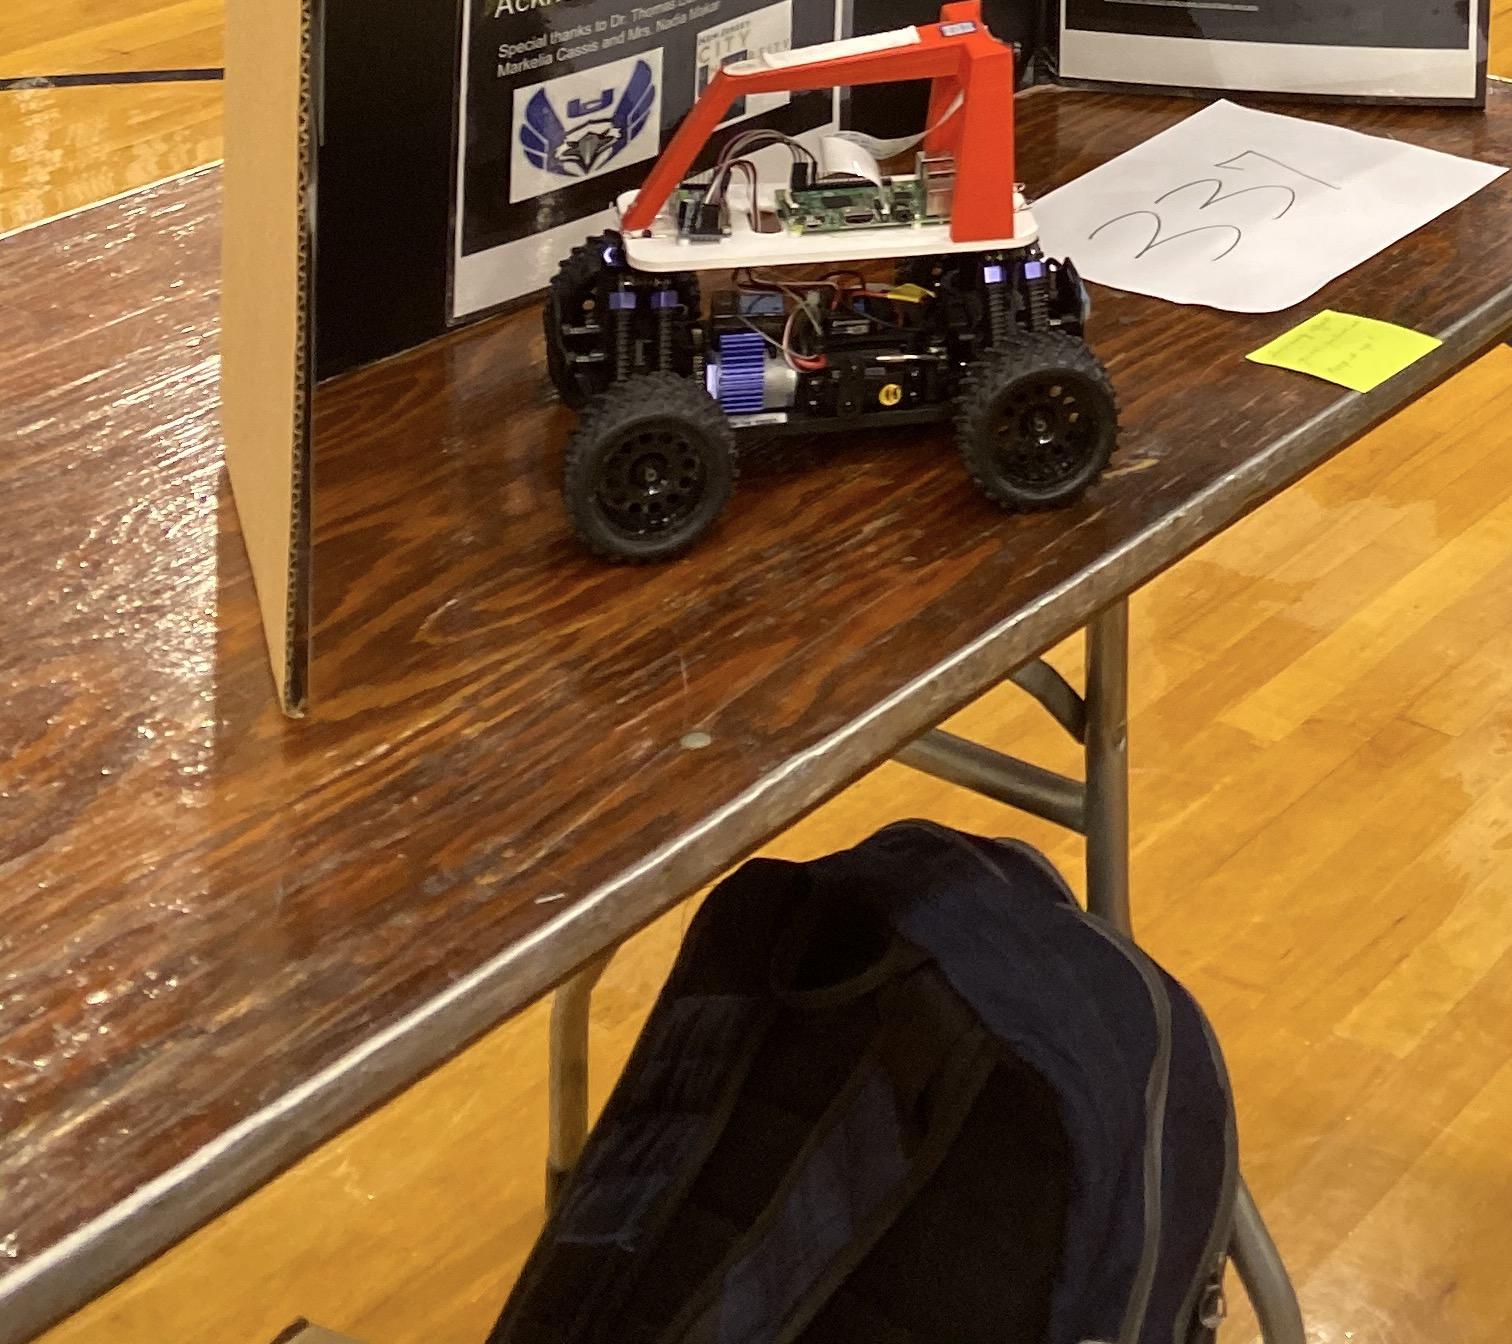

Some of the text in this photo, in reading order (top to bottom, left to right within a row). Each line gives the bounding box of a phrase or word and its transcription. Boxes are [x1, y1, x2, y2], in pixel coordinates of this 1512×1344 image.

[498, 33, 548, 59] Special
[550, 25, 592, 45] thanks
[595, 20, 607, 32] to
[602, 31, 626, 49] and
